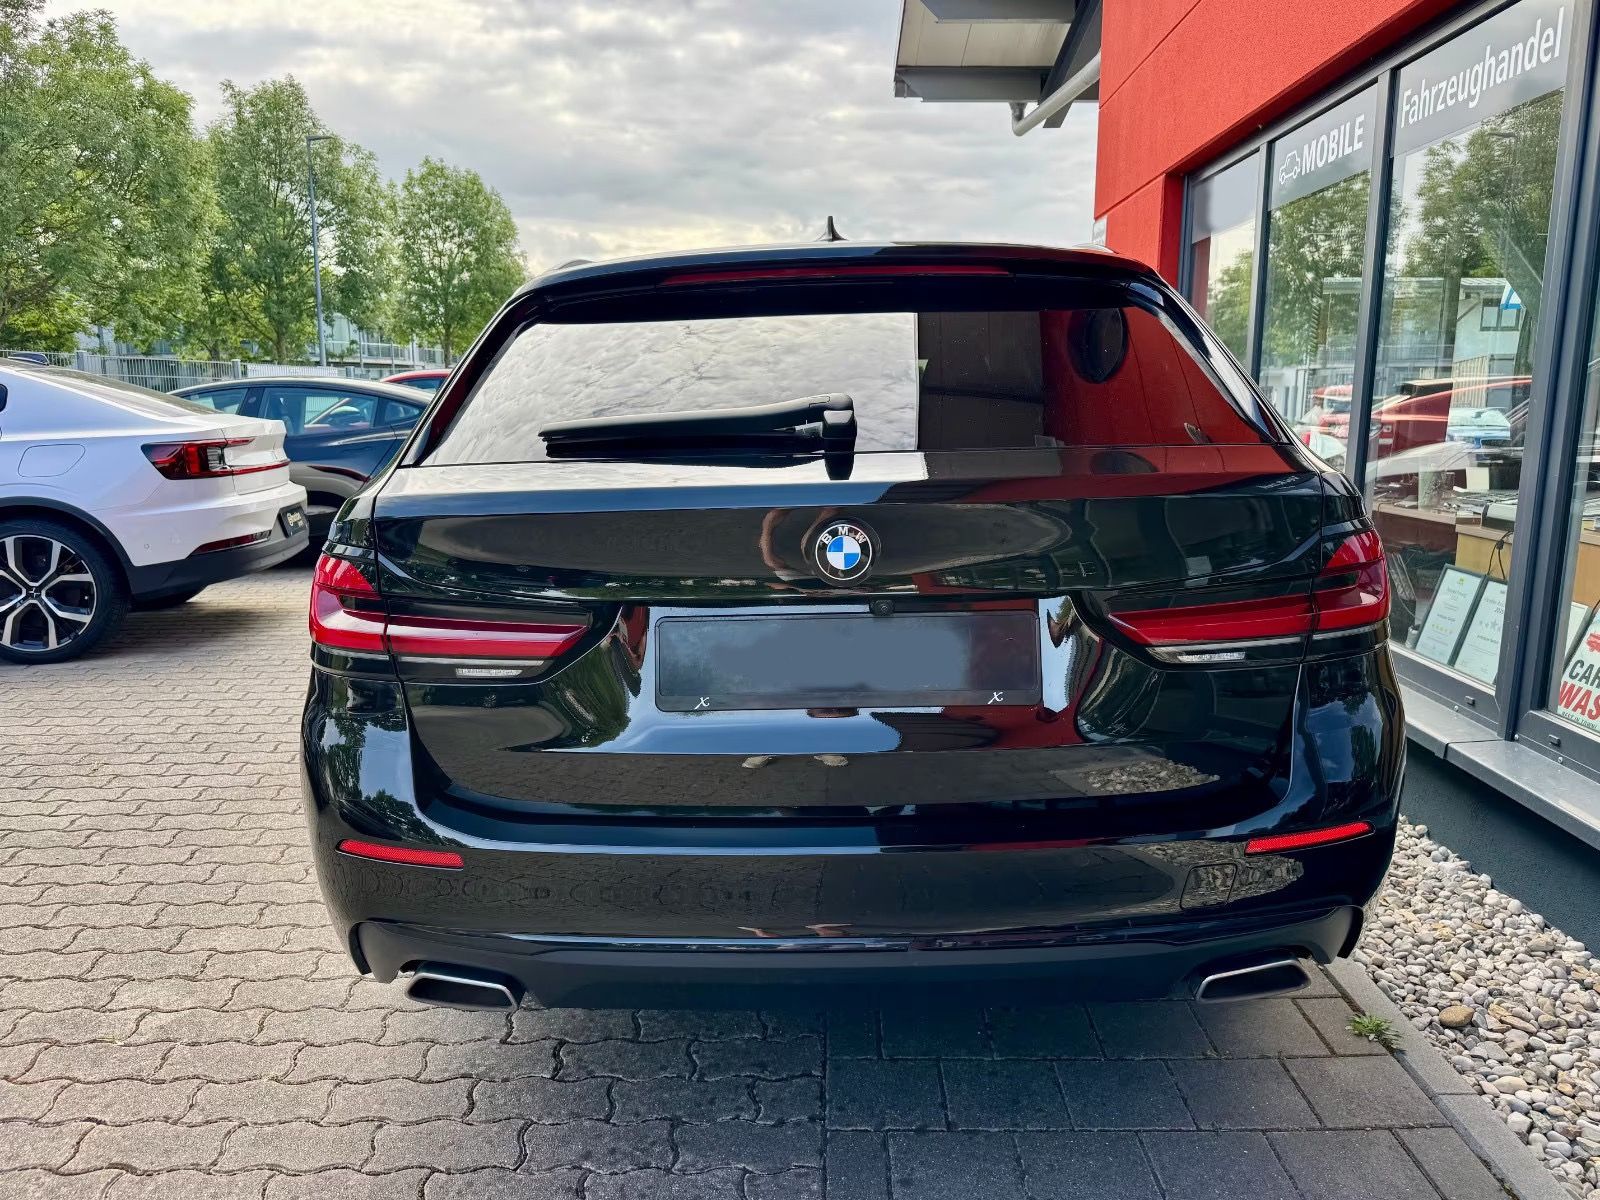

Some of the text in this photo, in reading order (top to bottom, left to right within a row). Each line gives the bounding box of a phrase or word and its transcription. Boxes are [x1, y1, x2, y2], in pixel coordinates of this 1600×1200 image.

[1400, 7, 1565, 128] Fahrzeughandel
[1301, 114, 1365, 176] MOBILE
[821, 526, 867, 545] BMW
